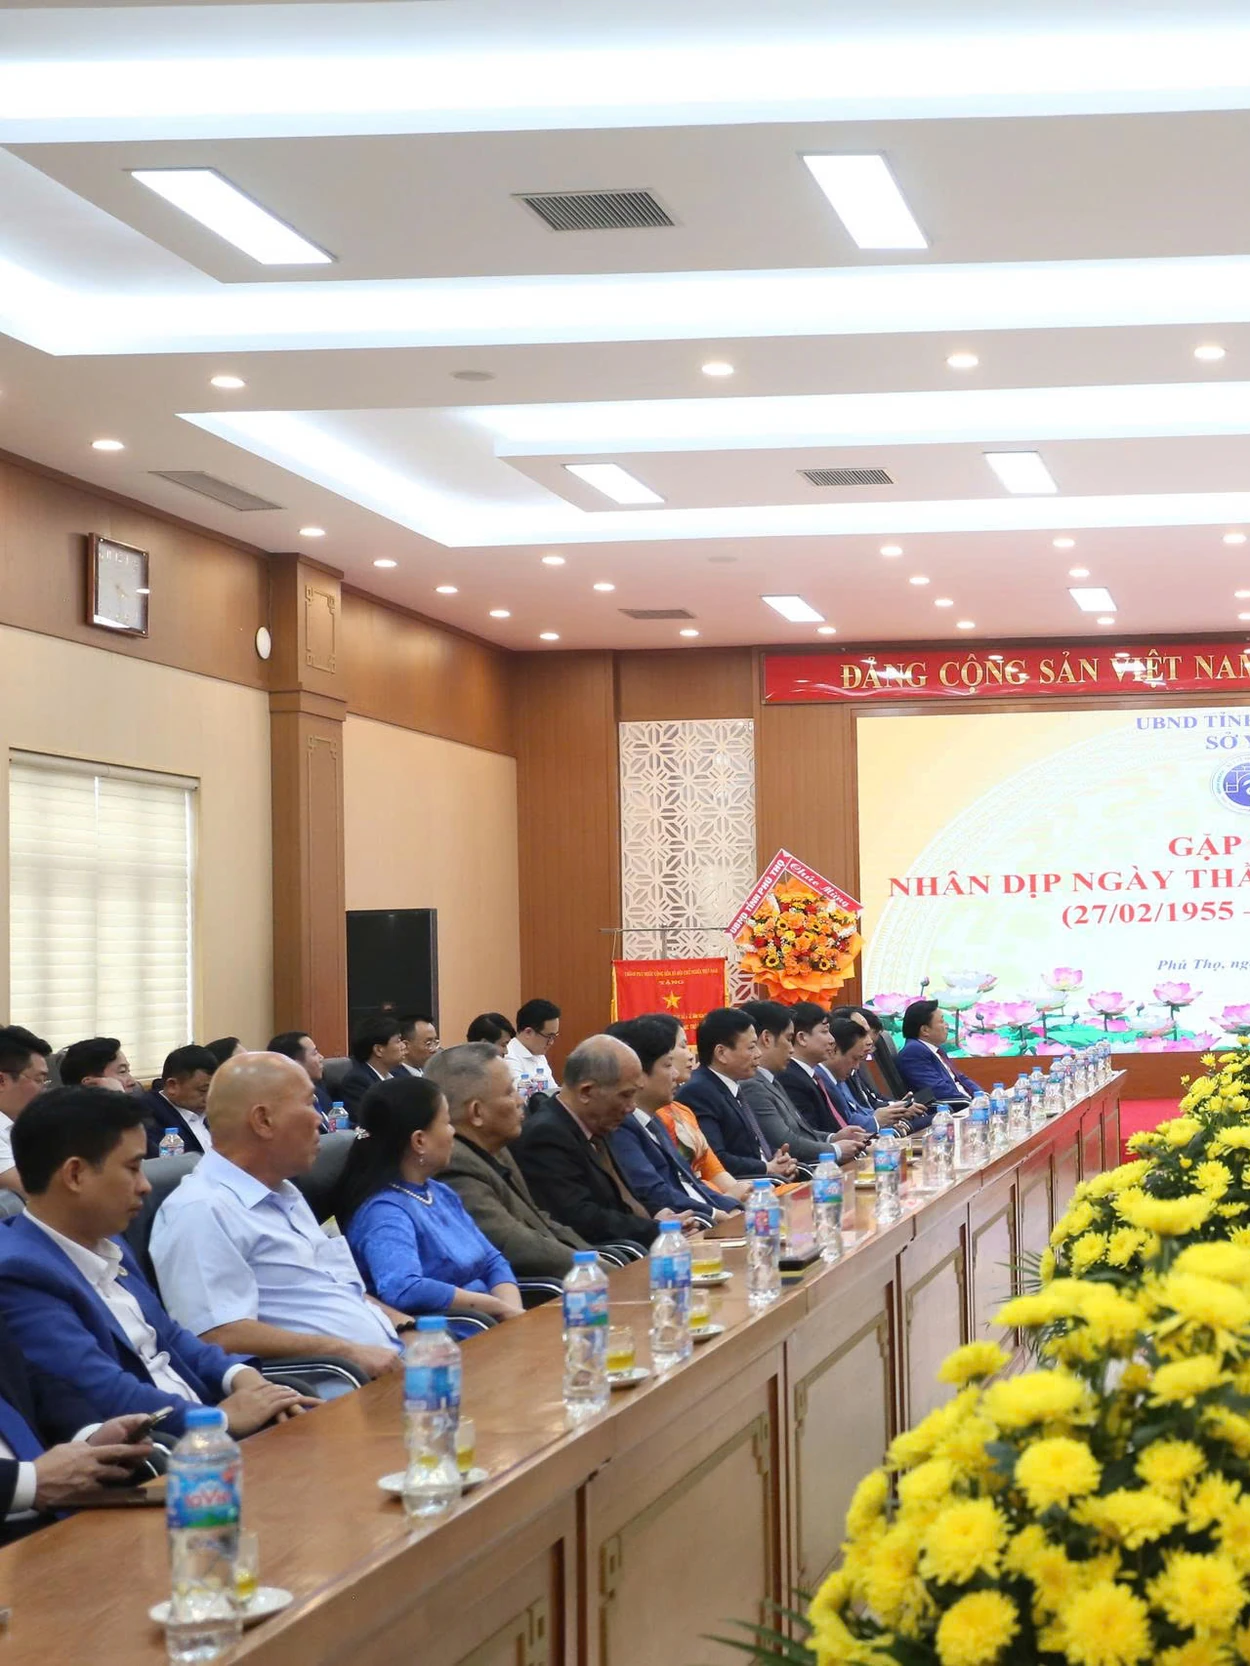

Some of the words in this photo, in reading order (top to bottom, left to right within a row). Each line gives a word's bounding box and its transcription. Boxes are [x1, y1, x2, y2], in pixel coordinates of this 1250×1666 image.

[840, 656, 928, 690] ĐẢNG
[939, 653, 1029, 694] CỘNG
[1039, 651, 1099, 686] SẢN
[1109, 649, 1183, 688] VIỆT
[1136, 716, 1198, 730] UBND
[1205, 732, 1239, 750] SỞ
[1168, 833, 1242, 861] GẶP
[789, 862, 820, 887] Chúc
[888, 870, 991, 897] NHÂN
[1003, 873, 1062, 898] DỊP
[1072, 866, 1173, 892] NGÀY
[746, 894, 761, 913] TỈNH
[757, 876, 773, 896] PHÚ
[1062, 901, 1234, 929] (27/02/1955
